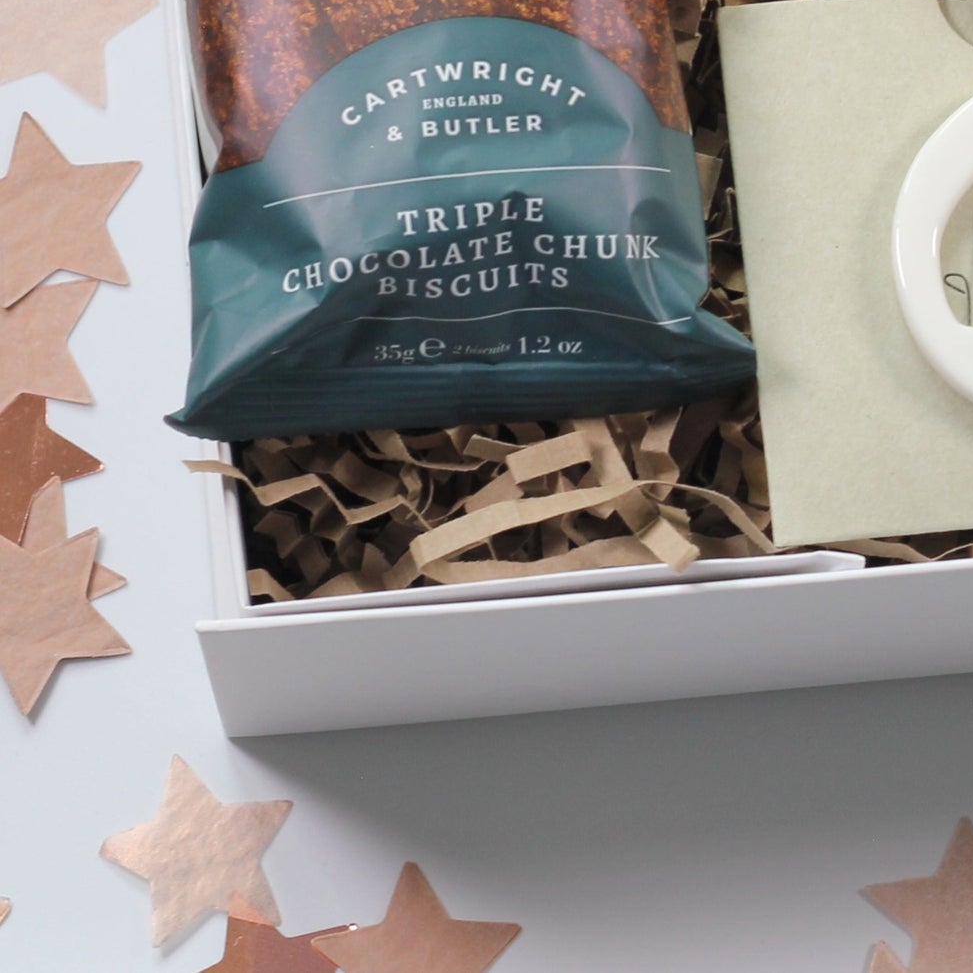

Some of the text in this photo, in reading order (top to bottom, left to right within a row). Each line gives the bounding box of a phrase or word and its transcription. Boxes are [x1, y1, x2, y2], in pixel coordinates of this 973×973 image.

[340, 61, 586, 126] CARTWRIGHT
[422, 93, 503, 110] ENGLAND
[387, 114, 543, 142] & BUTLER
[397, 198, 544, 236] TRIPLE
[282, 231, 660, 294] CHOCOLATE CHUNK
[378, 262, 569, 298] BISCUITS
[518, 335, 551, 354] 1.2
[558, 340, 583, 354] oz
